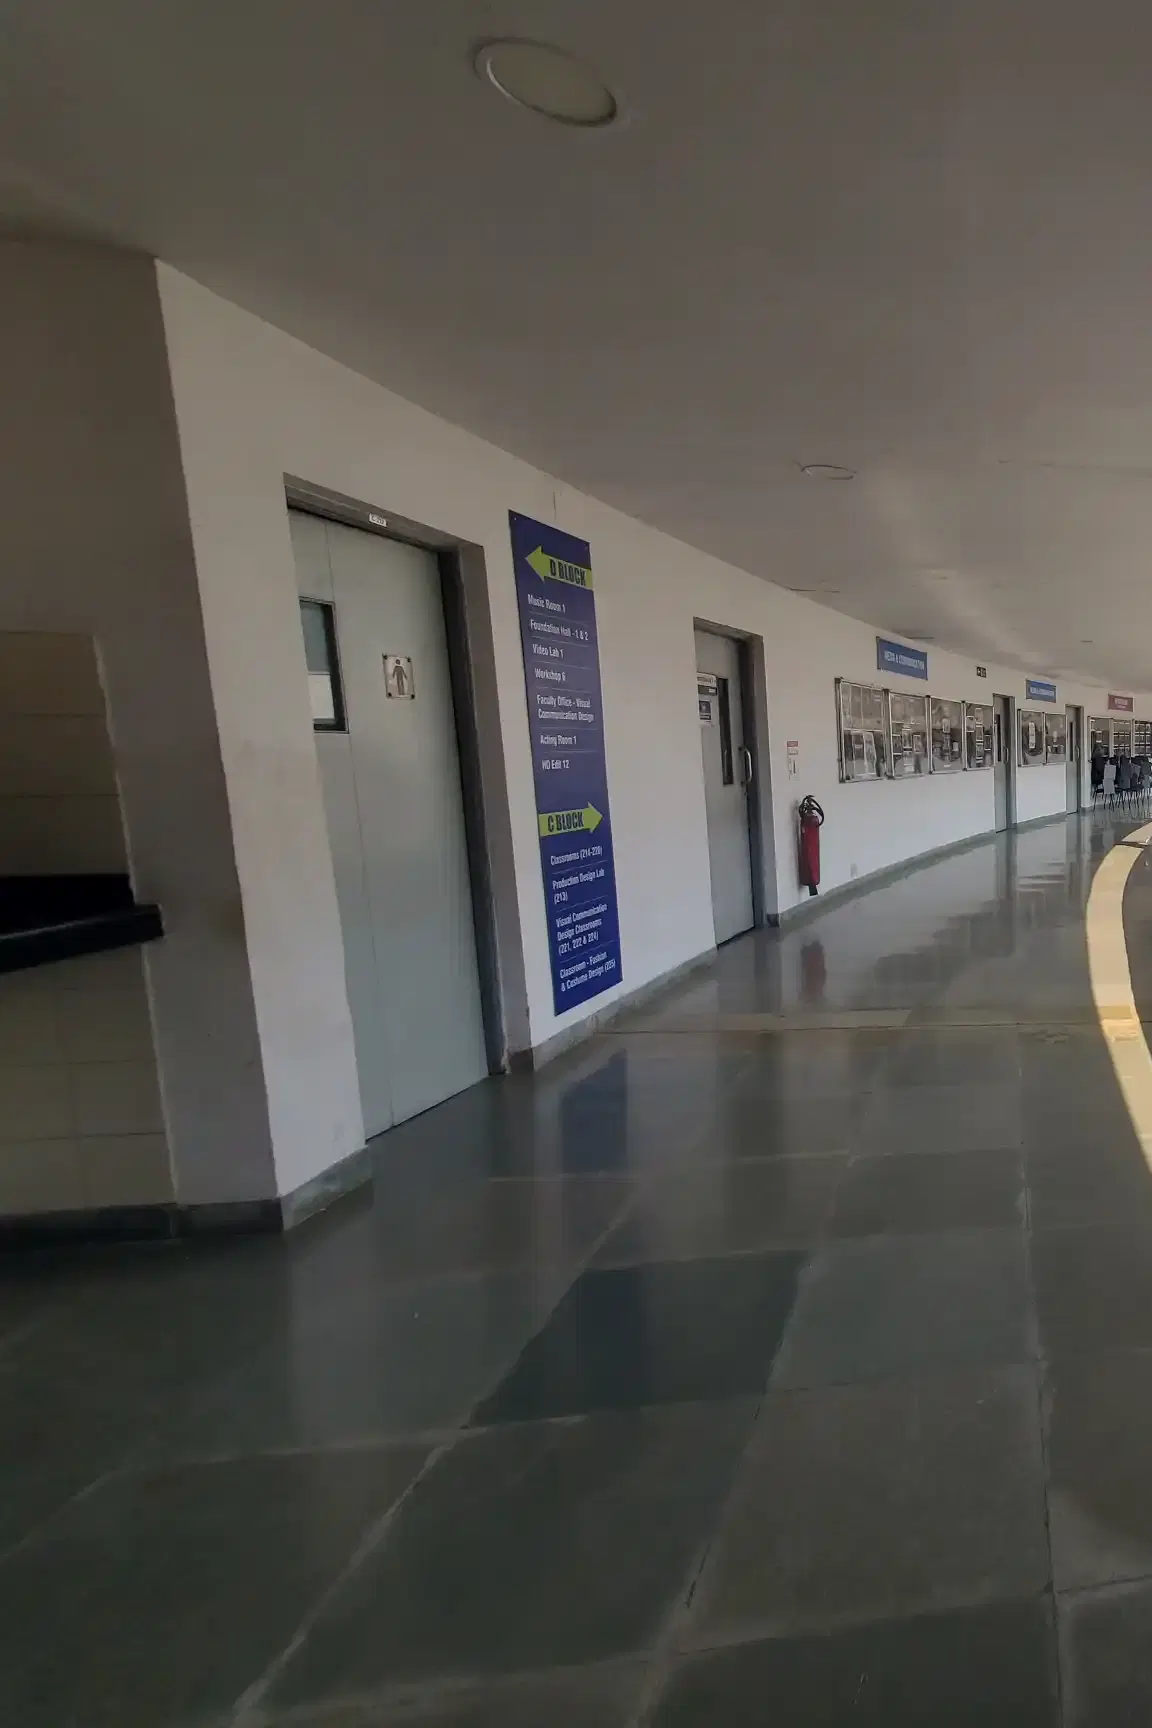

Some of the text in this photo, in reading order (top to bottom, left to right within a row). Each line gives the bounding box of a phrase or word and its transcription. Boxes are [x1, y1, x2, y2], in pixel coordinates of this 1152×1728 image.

[550, 558, 586, 586] D BLOCK
[528, 594, 566, 614] Music Room 1
[530, 619, 560, 634] Foundation
[561, 625, 571, 637] Hall
[575, 630, 579, 639] 1
[580, 630, 584, 640] &
[584, 631, 589, 641] 2
[532, 644, 564, 659] Video Lab 1
[535, 668, 561, 683] Workshop
[537, 694, 556, 708] Faculty
[557, 696, 572, 707] Office
[576, 699, 590, 708] Visual
[538, 708, 594, 722] Communication Design
[540, 734, 577, 747] Acting Room 1
[551, 759, 561, 769] Edit
[562, 759, 570, 769] 12
[547, 812, 584, 832] C BLOCK
[550, 852, 579, 865] Classrooms
[552, 868, 605, 890] Production Design Lab
[554, 891, 568, 905] (213)
[556, 904, 608, 928] Visual Communication
[557, 919, 602, 941] Design Classrooms
[559, 931, 599, 956] (221, 222 & 224)
[560, 961, 587, 979] Classroom
[589, 951, 607, 965] Fashion
[561, 958, 616, 992] & Costume Design (225)
